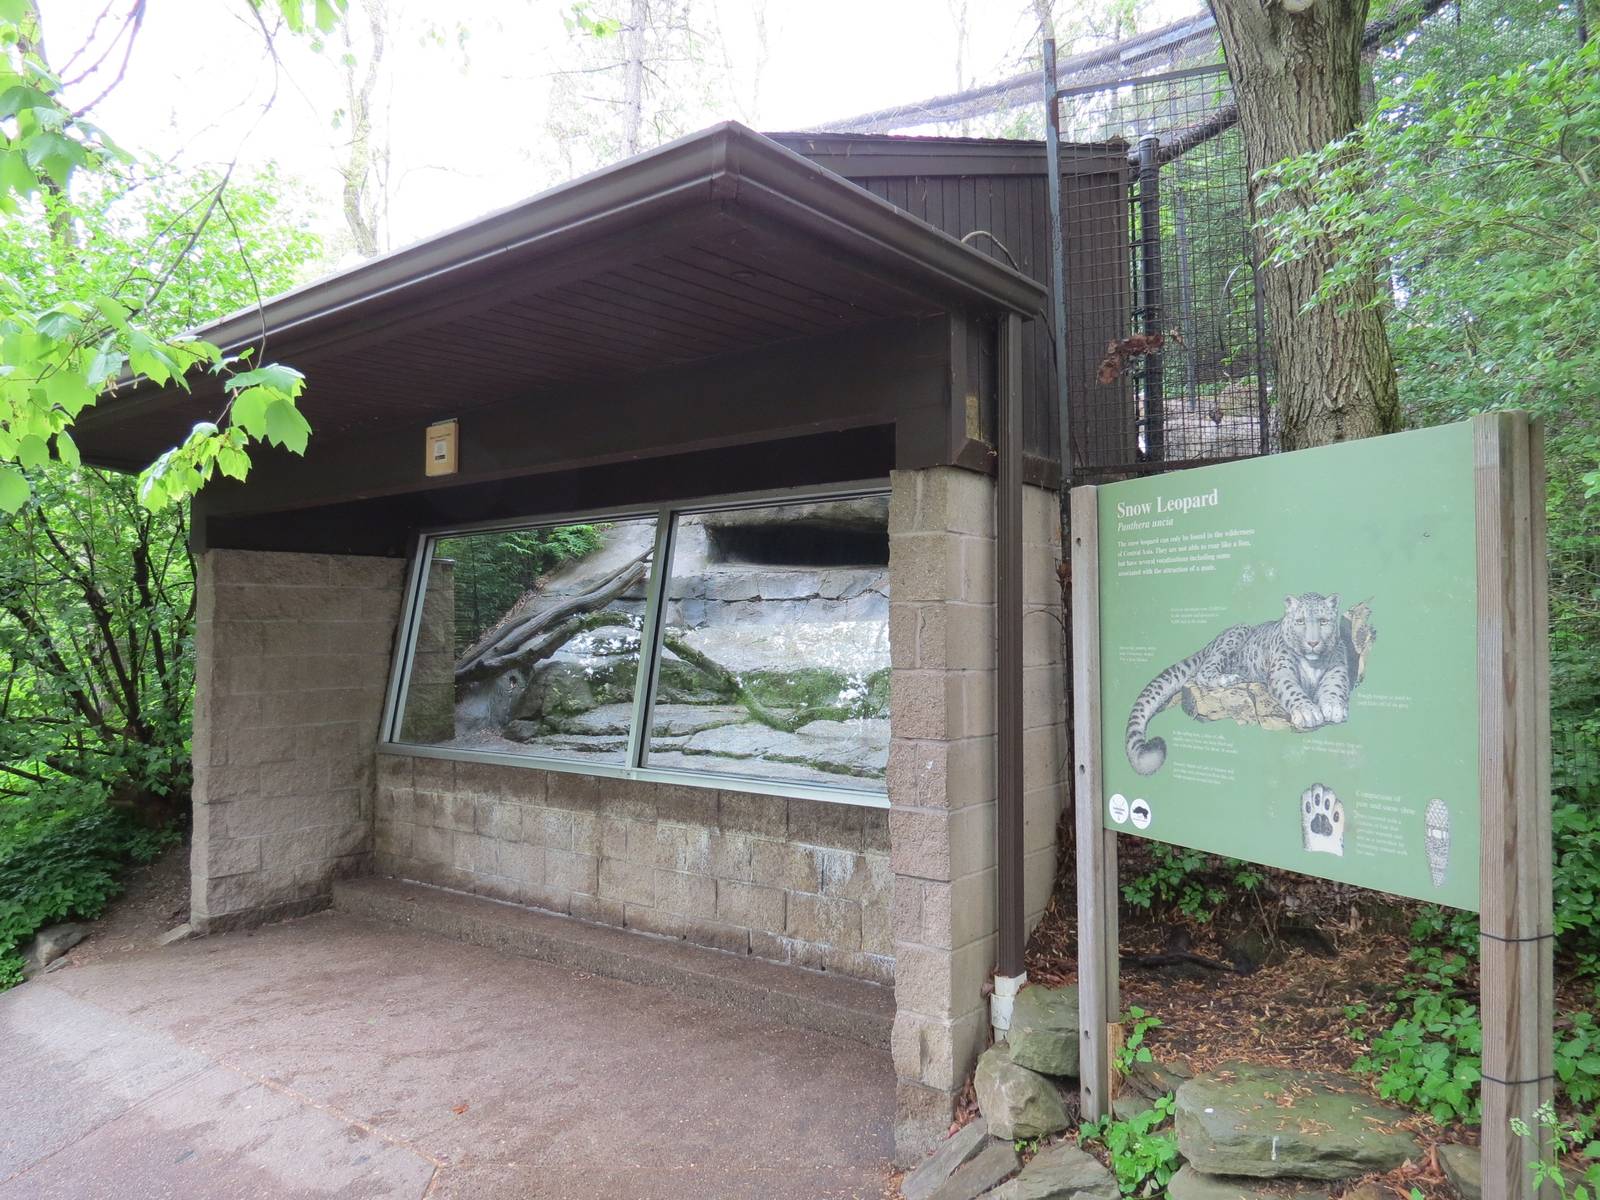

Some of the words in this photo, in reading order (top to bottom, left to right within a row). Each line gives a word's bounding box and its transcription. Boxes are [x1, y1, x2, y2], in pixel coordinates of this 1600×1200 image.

[1117, 502, 1152, 519] Snow
[1157, 488, 1218, 514] Leopard
[1117, 520, 1150, 533] Panthera
[1151, 518, 1174, 529] uncia
